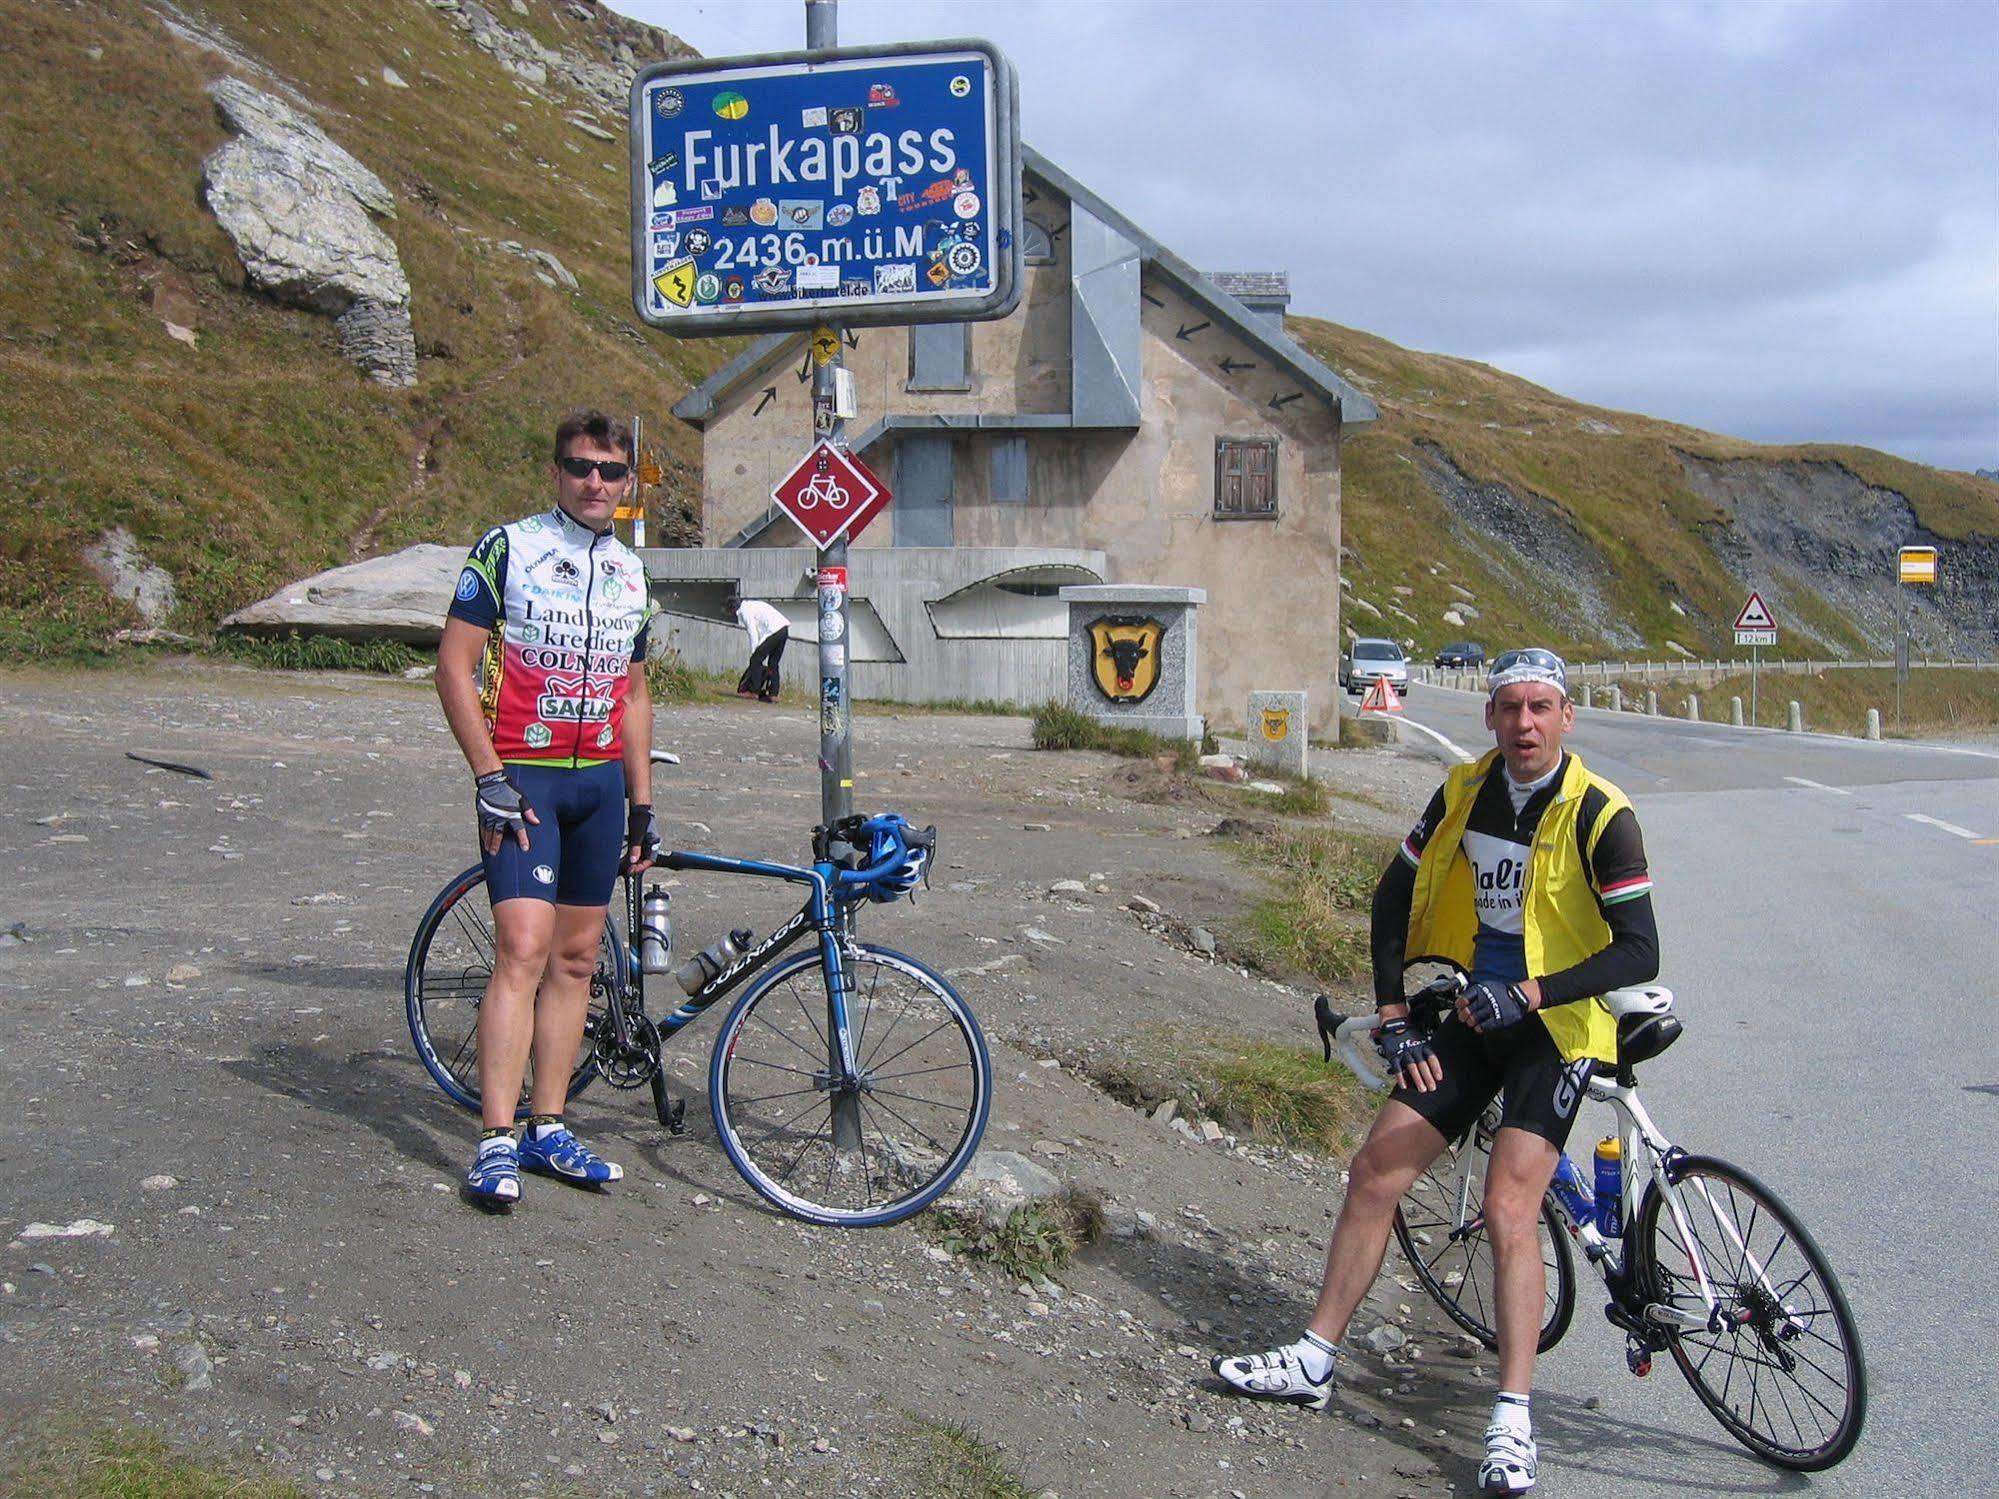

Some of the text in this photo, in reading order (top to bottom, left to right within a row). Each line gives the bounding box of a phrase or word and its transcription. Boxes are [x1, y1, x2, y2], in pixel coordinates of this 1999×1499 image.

[684, 123, 957, 197] Furkapass
[713, 232, 805, 270] 2436
[1755, 633, 1768, 643] km
[703, 912, 805, 995] COLNAGO
